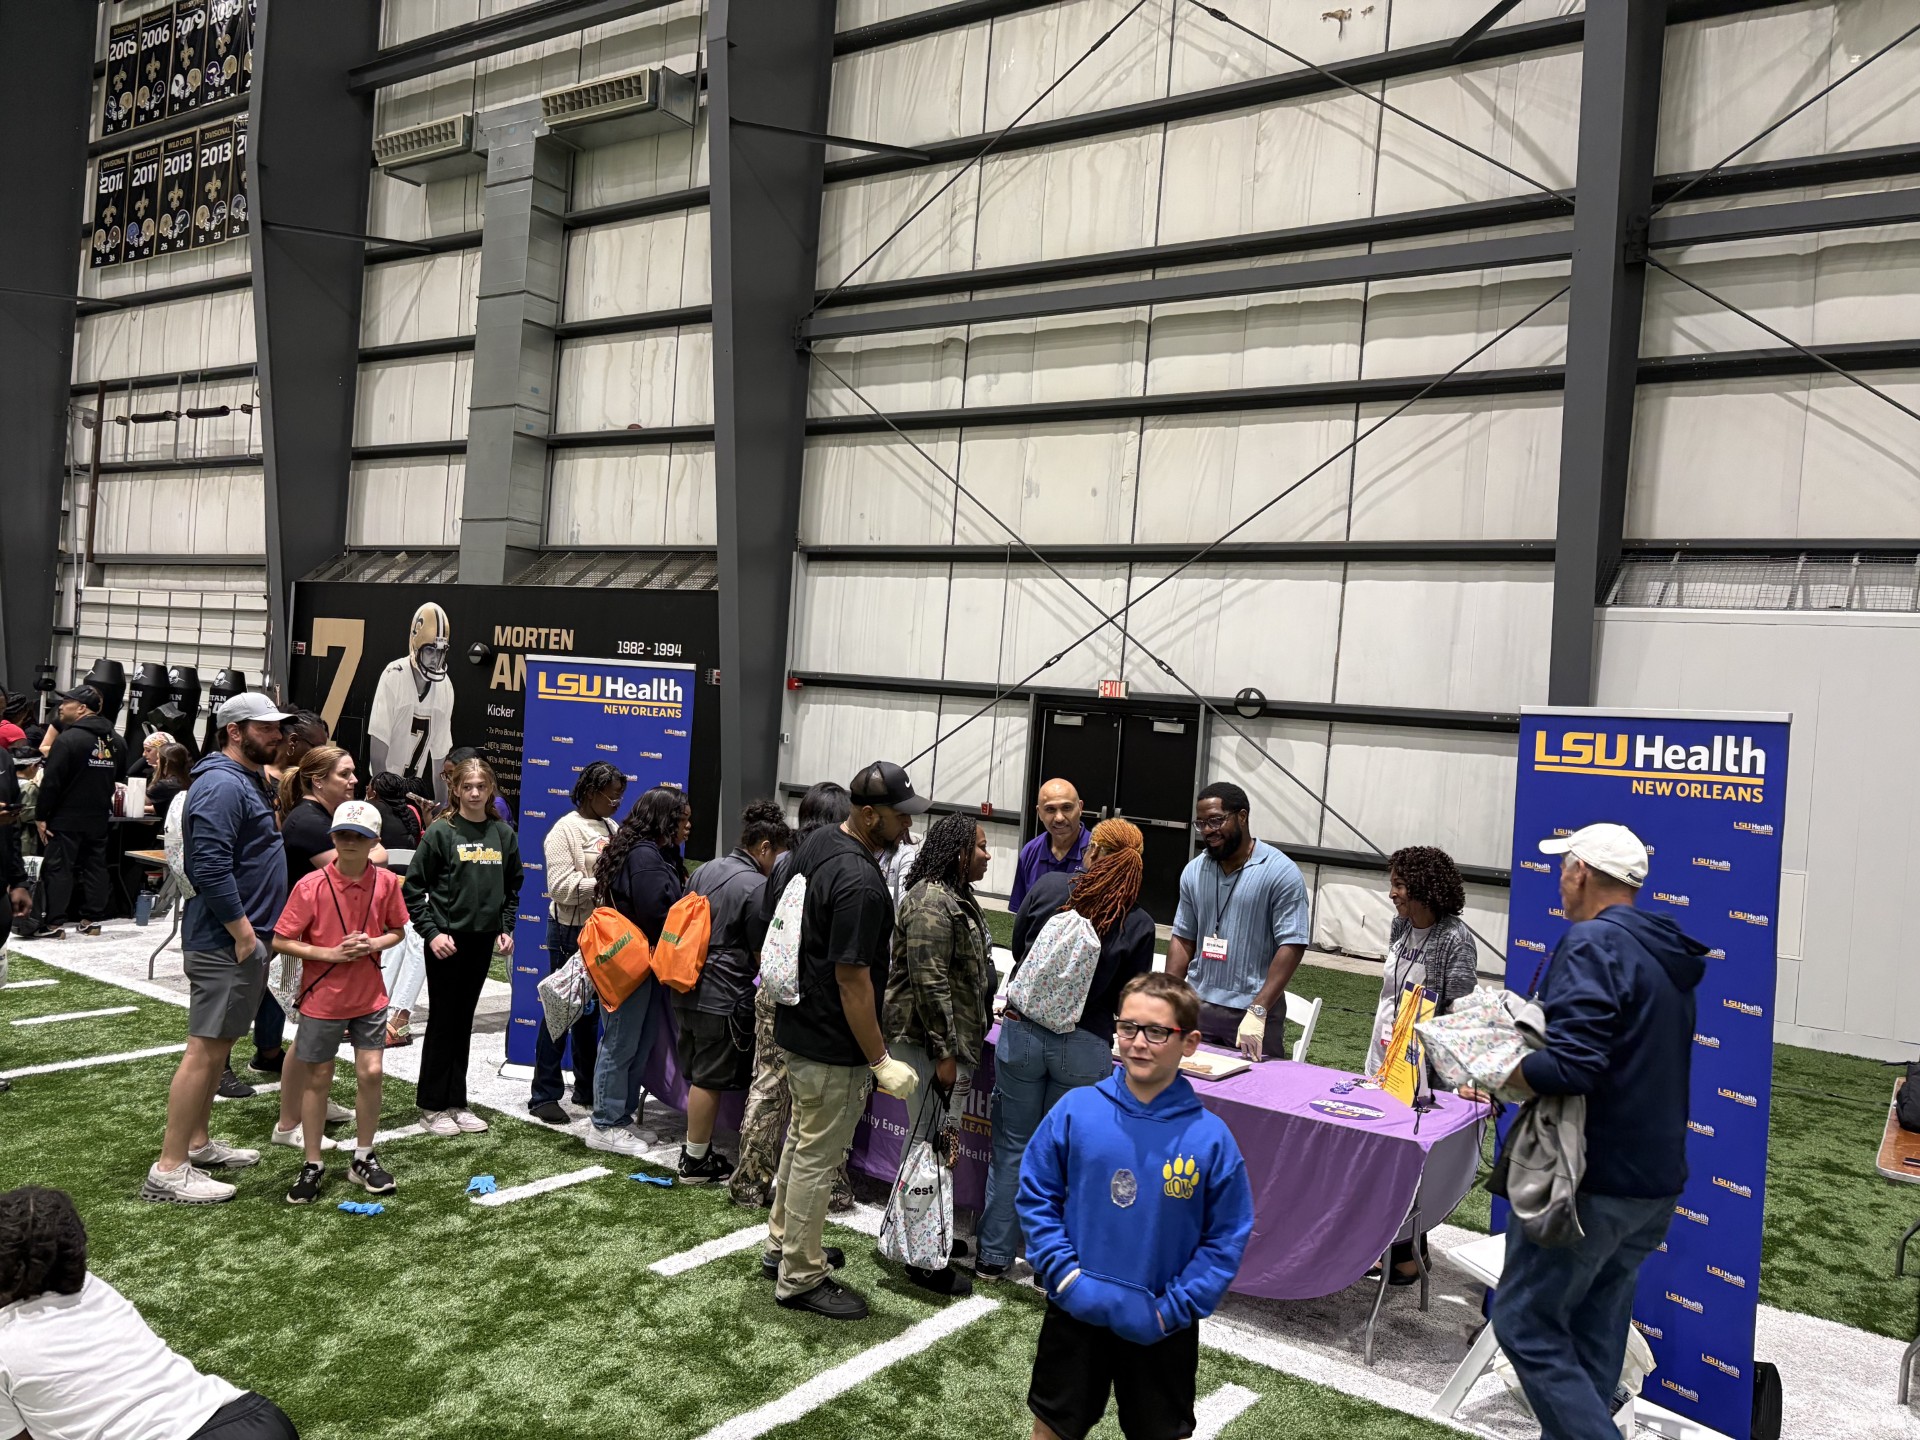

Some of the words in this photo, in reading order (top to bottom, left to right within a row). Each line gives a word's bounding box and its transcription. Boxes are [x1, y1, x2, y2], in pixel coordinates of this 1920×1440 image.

[141, 24, 170, 51] 2006
[204, 127, 231, 140] DIVISIONAL
[168, 140, 180, 150] WILD
[180, 136, 193, 147] CARD
[200, 142, 232, 168] 2013
[163, 152, 193, 177] 2013
[131, 162, 158, 187] 2011
[99, 172, 124, 194] 2011
[213, 231, 221, 240] 23
[176, 239, 184, 248] 24
[494, 625, 575, 651] MORTEN
[617, 640, 645, 655] 1982
[653, 642, 682, 657] 1994
[490, 653, 527, 692] AN
[538, 671, 601, 697] LSU
[605, 676, 683, 702] Health
[1103, 681, 1121, 698] EXIT
[487, 703, 515, 718] Kicker
[604, 704, 630, 715] NEW
[631, 707, 682, 719] ORLEANS
[495, 727, 504, 736] Pro
[503, 728, 516, 737] Bowl
[1535, 730, 1628, 767] LSU
[1635, 735, 1766, 775] Health
[1632, 780, 1673, 796] NEW
[1676, 783, 1764, 803] ORLEANS
[1751, 823, 1773, 831] Health
[1520, 860, 1534, 868] LSU
[1534, 862, 1551, 870] Health
[1692, 857, 1709, 865] LSU
[1710, 859, 1731, 867] Health
[1670, 894, 1689, 902] Health
[1549, 908, 1563, 916] LSU
[1729, 910, 1746, 918] LSU
[1747, 913, 1768, 921] Health
[1529, 941, 1546, 949] Health
[1709, 948, 1725, 956] ealth
[1723, 999, 1741, 1008] LSU
[1741, 1003, 1762, 1012] Health
[1699, 1034, 1720, 1044] Health
[1718, 1087, 1735, 1097] LSU
[1735, 1092, 1757, 1103] Health
[1694, 1121, 1715, 1132] Health
[1713, 1176, 1730, 1186] LSU
[1730, 1181, 1752, 1193] Health
[1688, 1209, 1709, 1221] Health
[1706, 1264, 1724, 1276] LSU
[1724, 1271, 1745, 1284] Health
[1666, 1291, 1682, 1302] LSU
[1683, 1297, 1704, 1309] Health
[1643, 1323, 1663, 1336] Health
[1701, 1353, 1719, 1365] LSU
[1719, 1360, 1740, 1374] Health
[1661, 1378, 1678, 1390] LSU
[1678, 1385, 1699, 1399] Health
